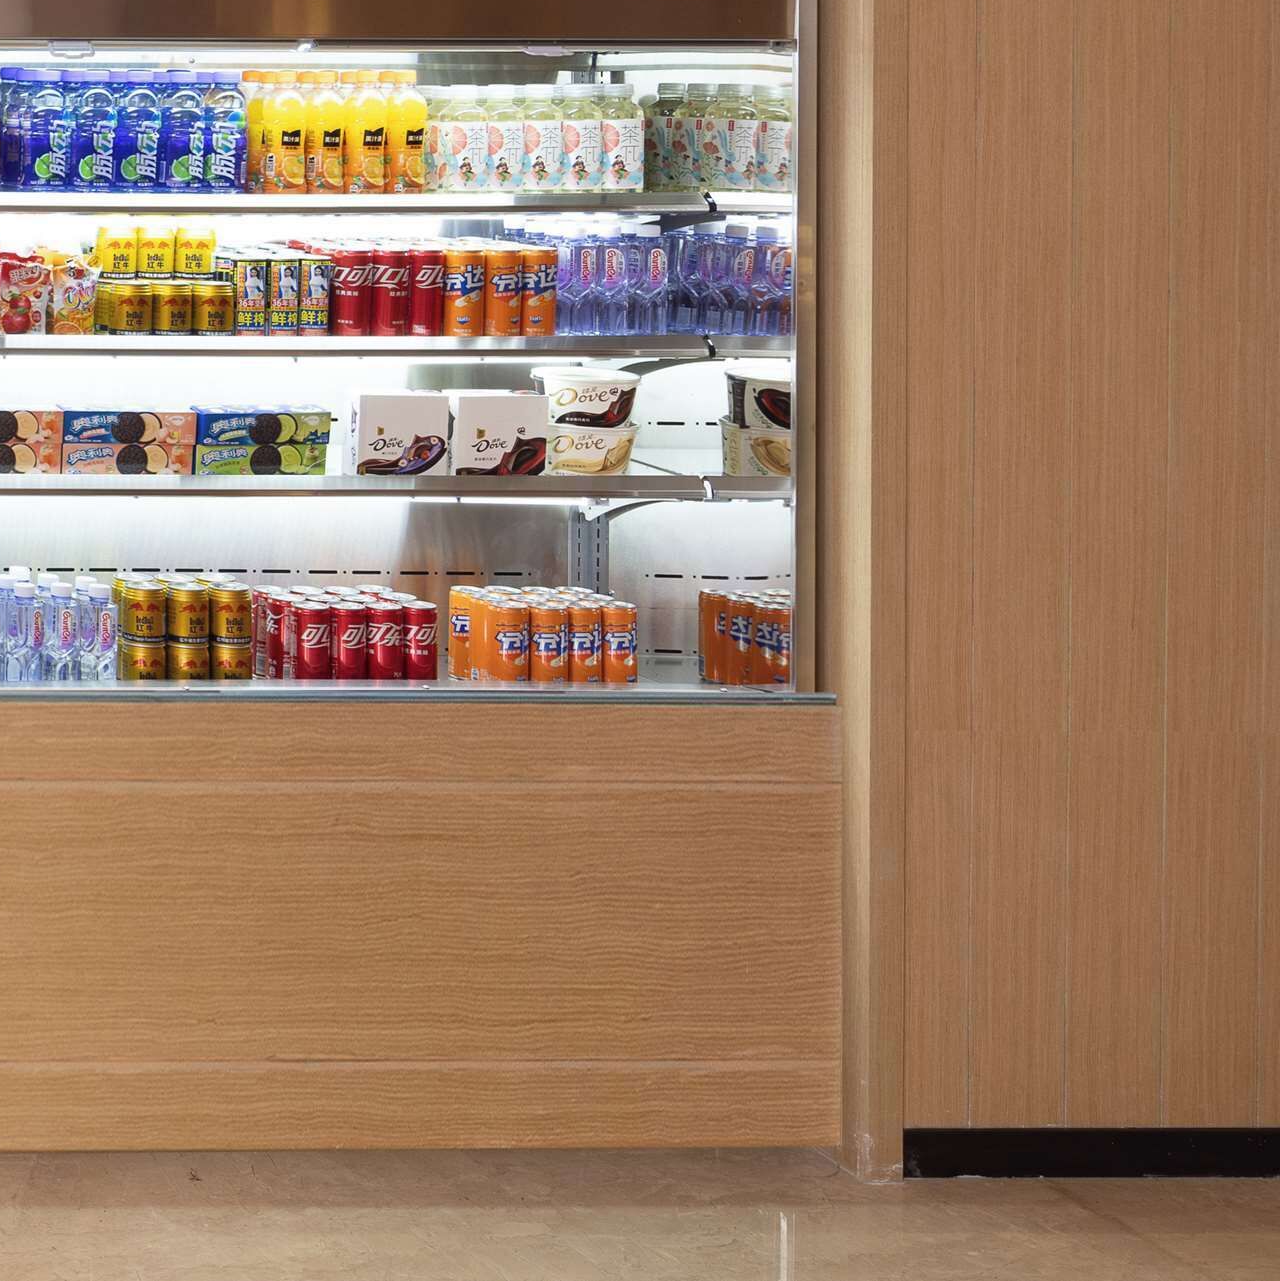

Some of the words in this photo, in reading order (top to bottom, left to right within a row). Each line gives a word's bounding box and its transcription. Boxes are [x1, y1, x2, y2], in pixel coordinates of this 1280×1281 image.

[549, 387, 609, 406] Dove
[369, 438, 404, 450] Dove
[472, 439, 508, 452] Dove
[544, 434, 606, 453] Dove
